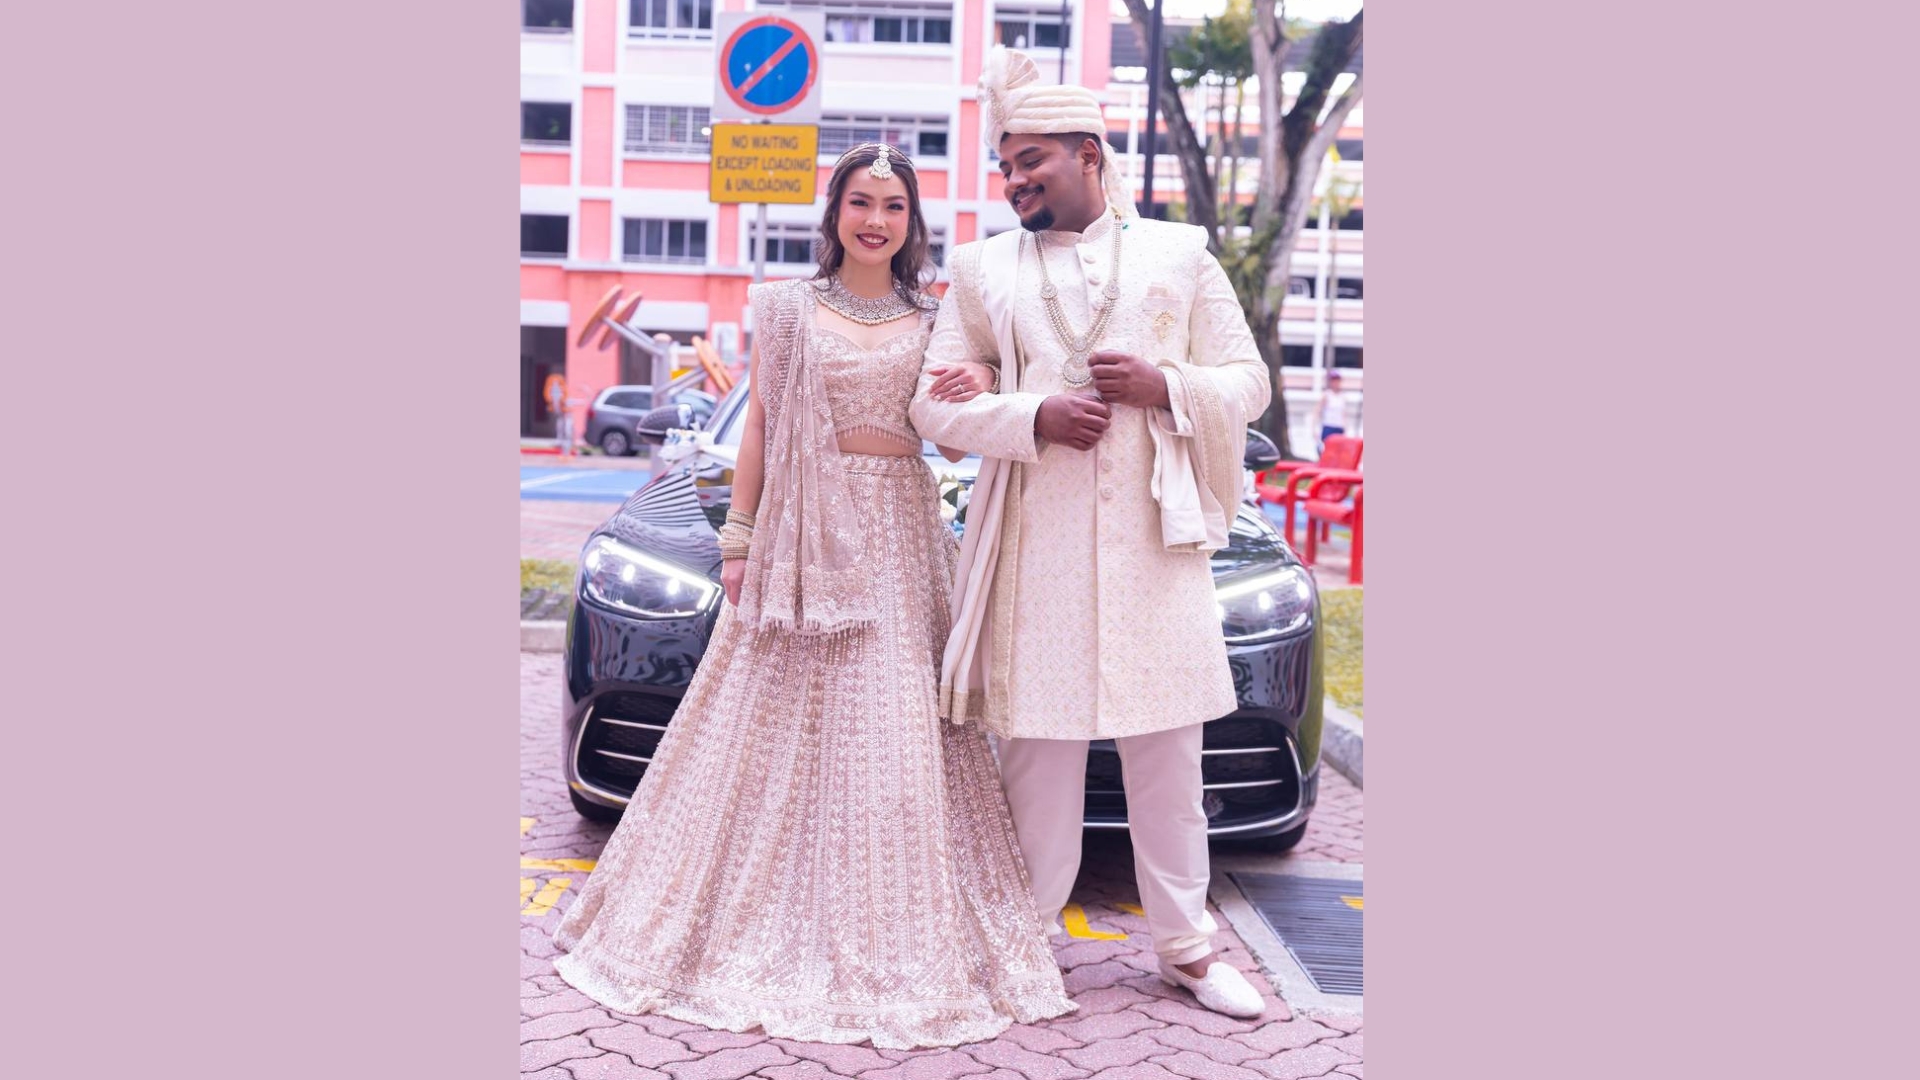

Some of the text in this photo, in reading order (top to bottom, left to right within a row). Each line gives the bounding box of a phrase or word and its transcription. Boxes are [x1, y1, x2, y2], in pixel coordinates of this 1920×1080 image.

[732, 135, 798, 149] NO WAITING
[717, 156, 812, 171] EXCEPT LOADING
[726, 178, 801, 193] & UNLOADING
